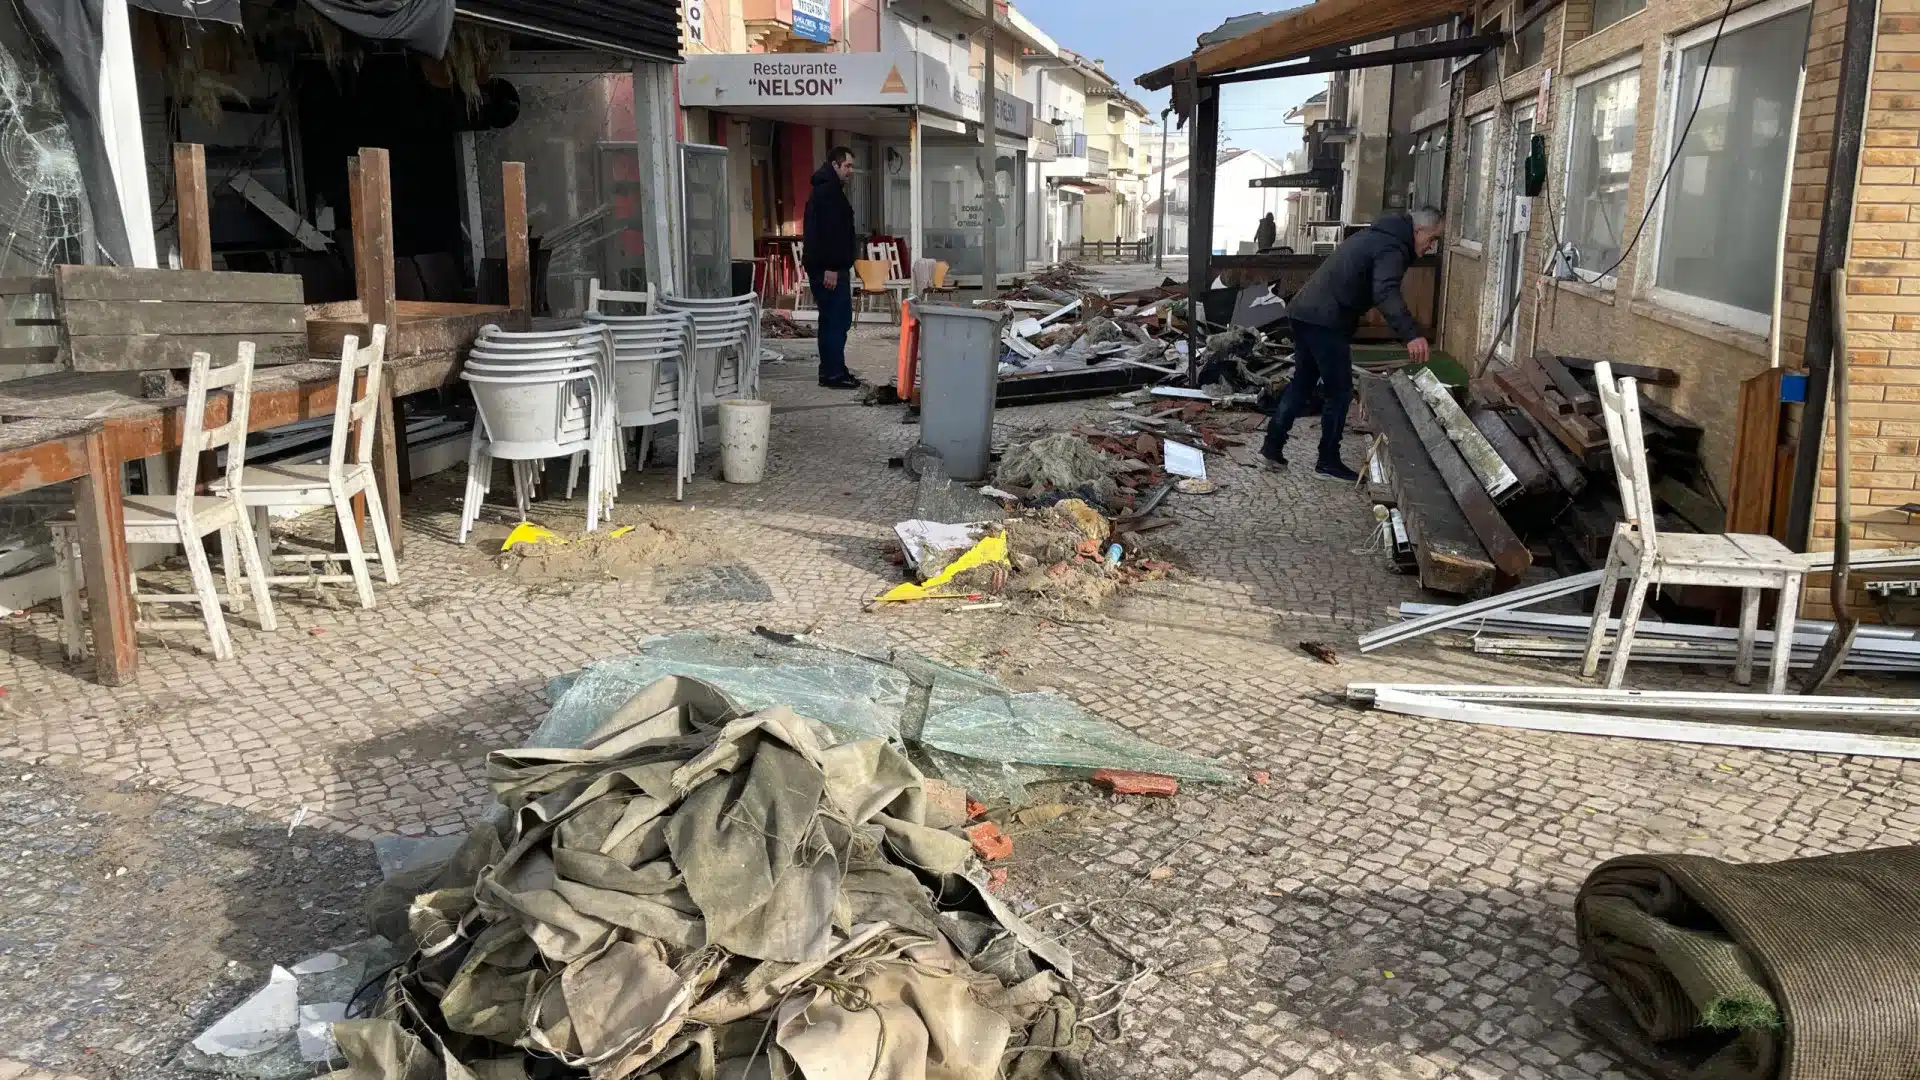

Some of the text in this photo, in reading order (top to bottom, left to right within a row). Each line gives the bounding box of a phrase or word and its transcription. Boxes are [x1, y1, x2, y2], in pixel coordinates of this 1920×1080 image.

[690, 0, 701, 40] ON
[753, 62, 837, 75] Restaurante
[748, 78, 843, 96] “NELSON”
